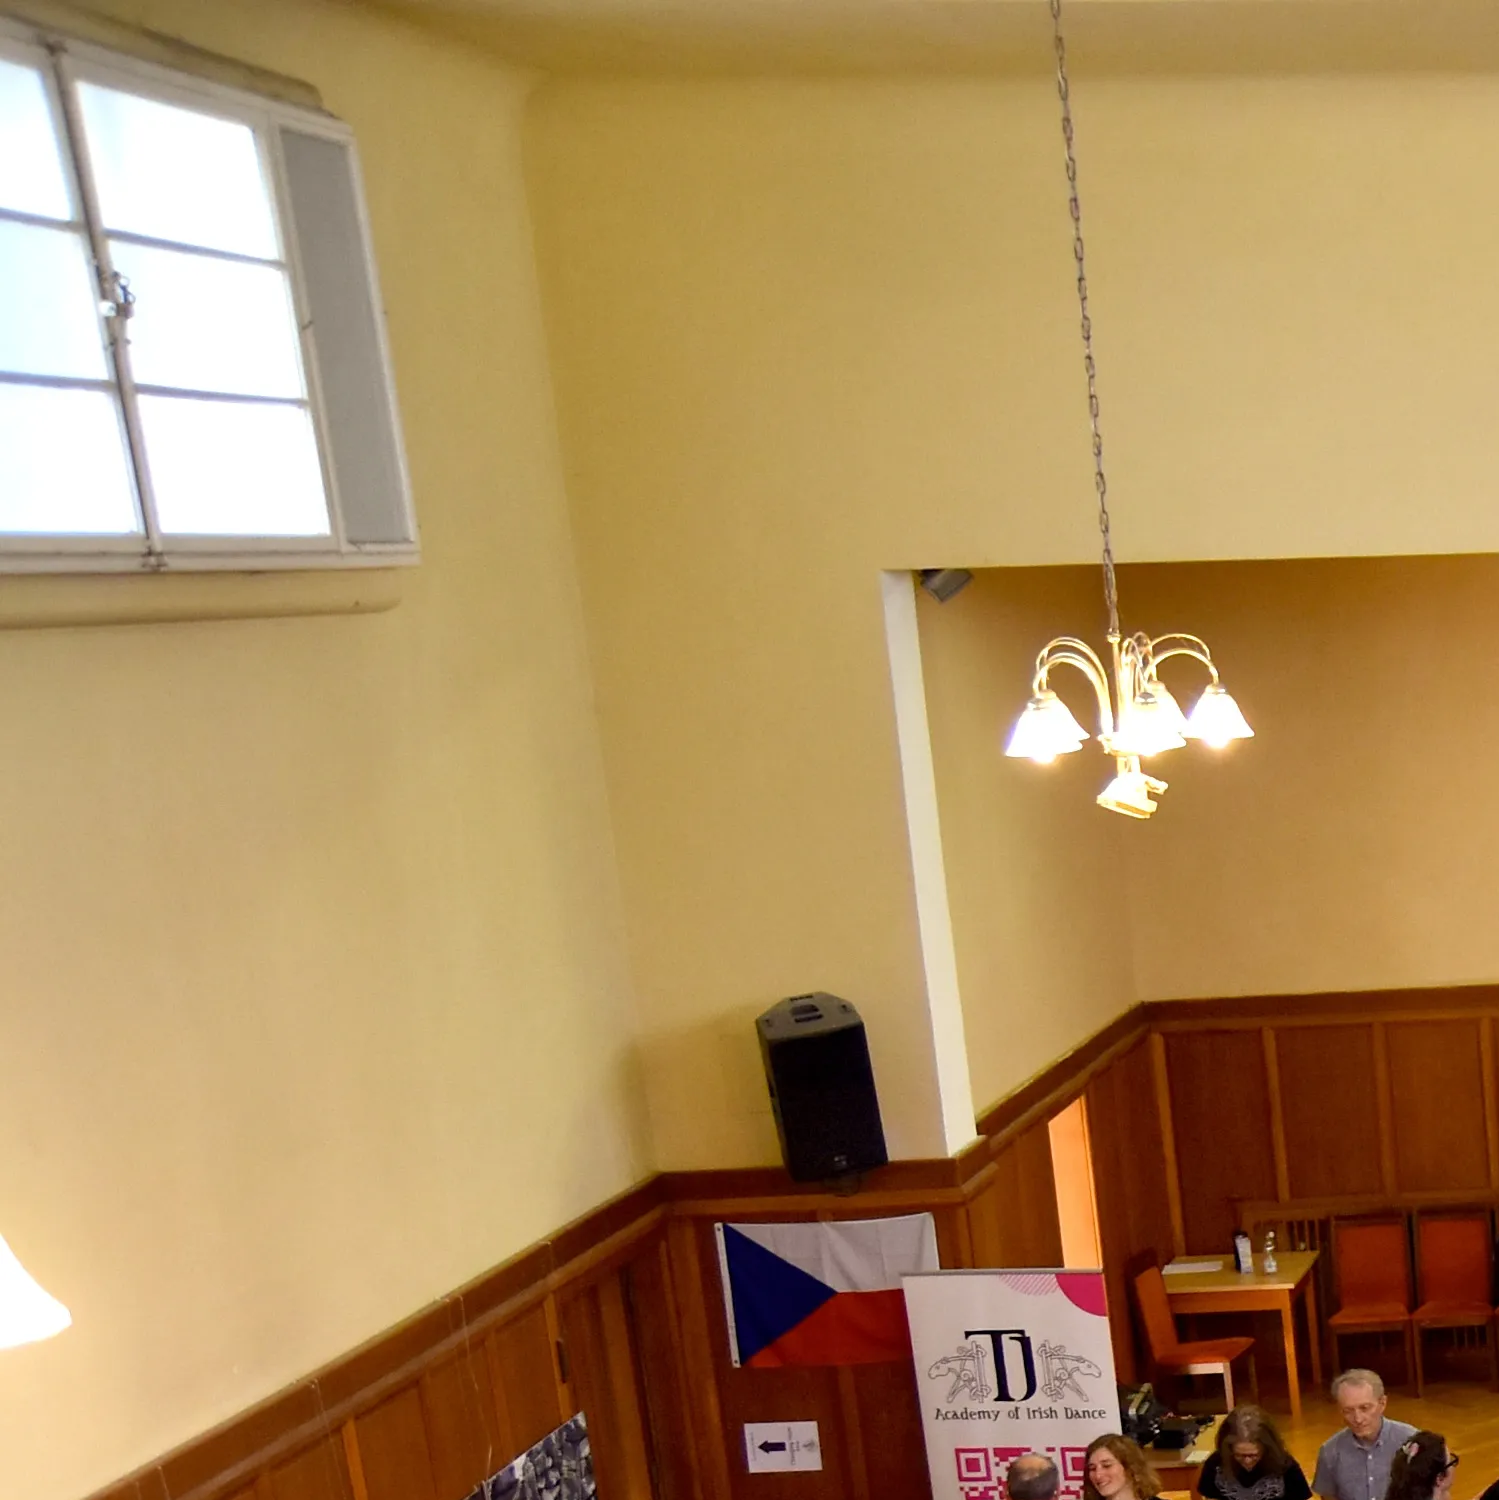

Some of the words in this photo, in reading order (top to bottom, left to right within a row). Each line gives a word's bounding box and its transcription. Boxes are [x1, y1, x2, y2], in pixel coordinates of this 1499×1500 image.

[935, 1407, 1000, 1421] Academy
[1008, 1406, 1020, 1420] of
[1027, 1406, 1058, 1420] Irish
[1064, 1406, 1107, 1420] Dance
